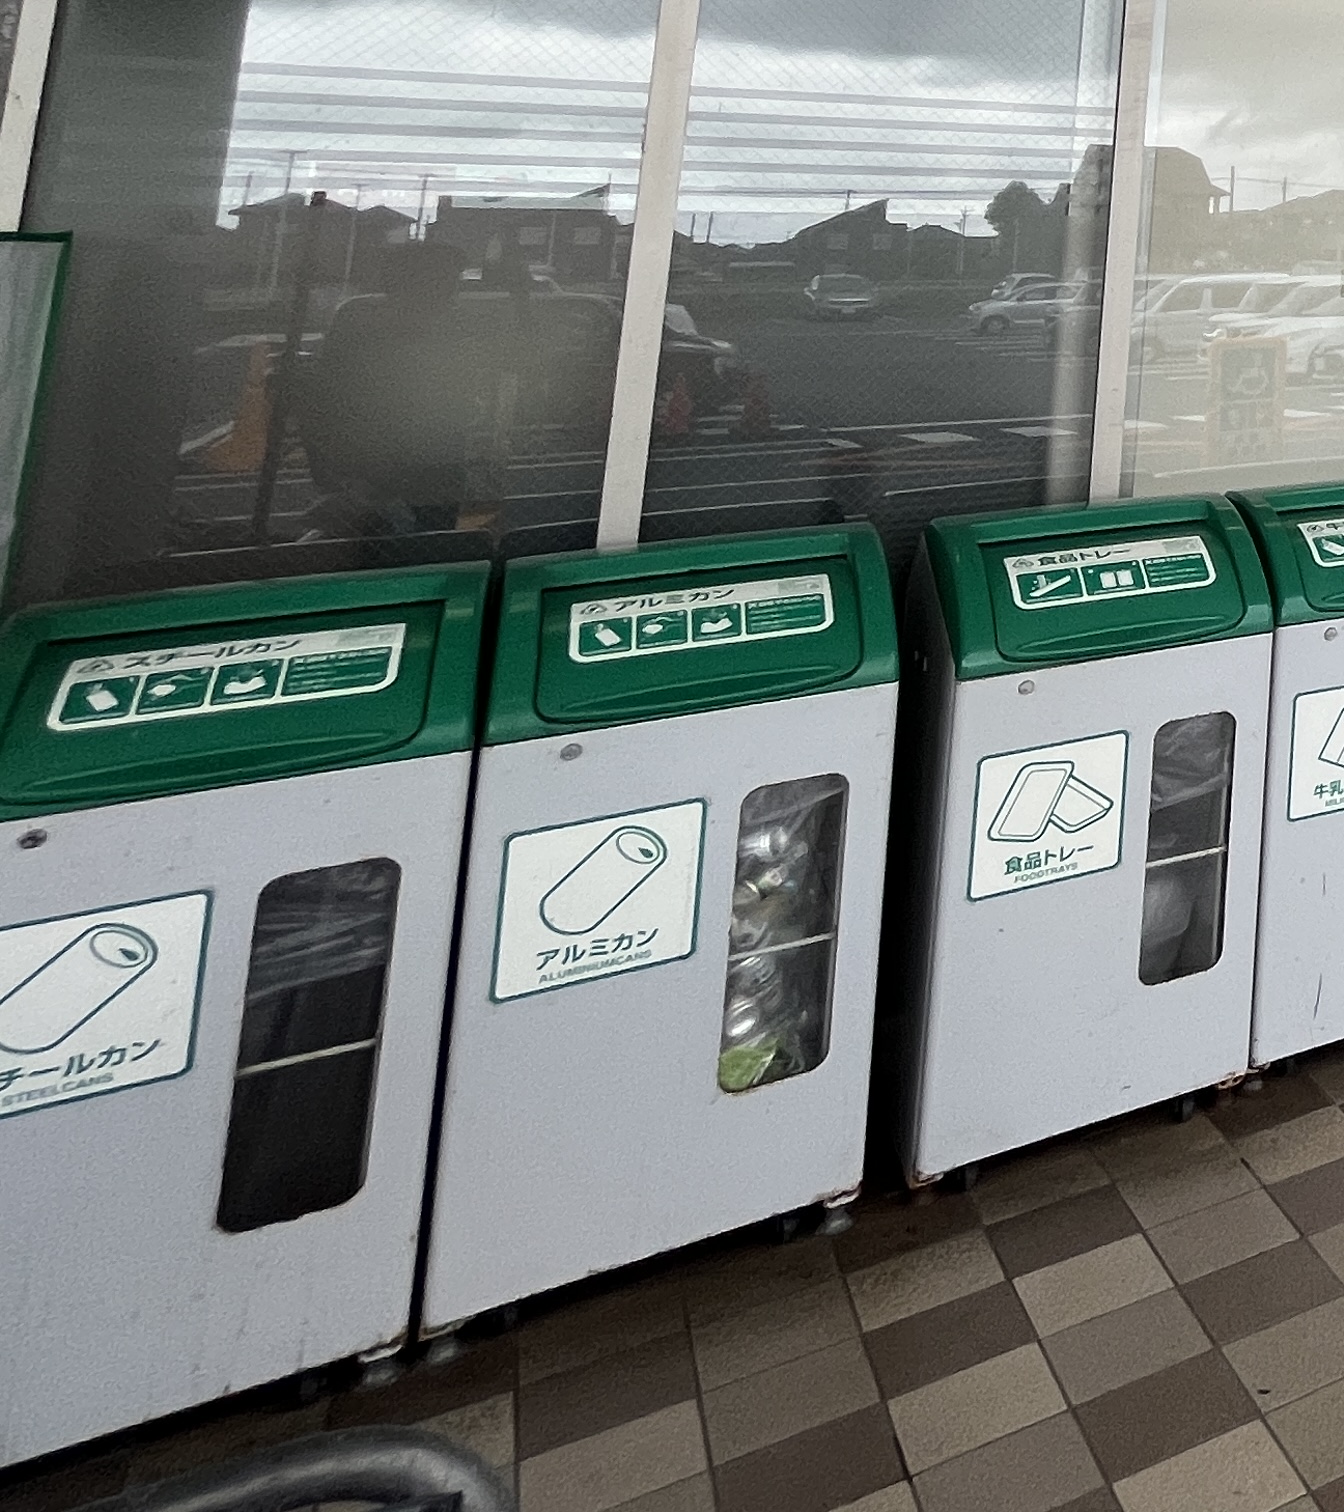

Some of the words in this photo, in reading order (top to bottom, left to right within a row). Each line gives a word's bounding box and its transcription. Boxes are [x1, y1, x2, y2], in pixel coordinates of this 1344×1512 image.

[615, 589, 735, 613] アルミカン
[123, 639, 301, 669] スチールカン
[1004, 845, 1095, 875] 食品トレー
[536, 928, 659, 971] アルミカン
